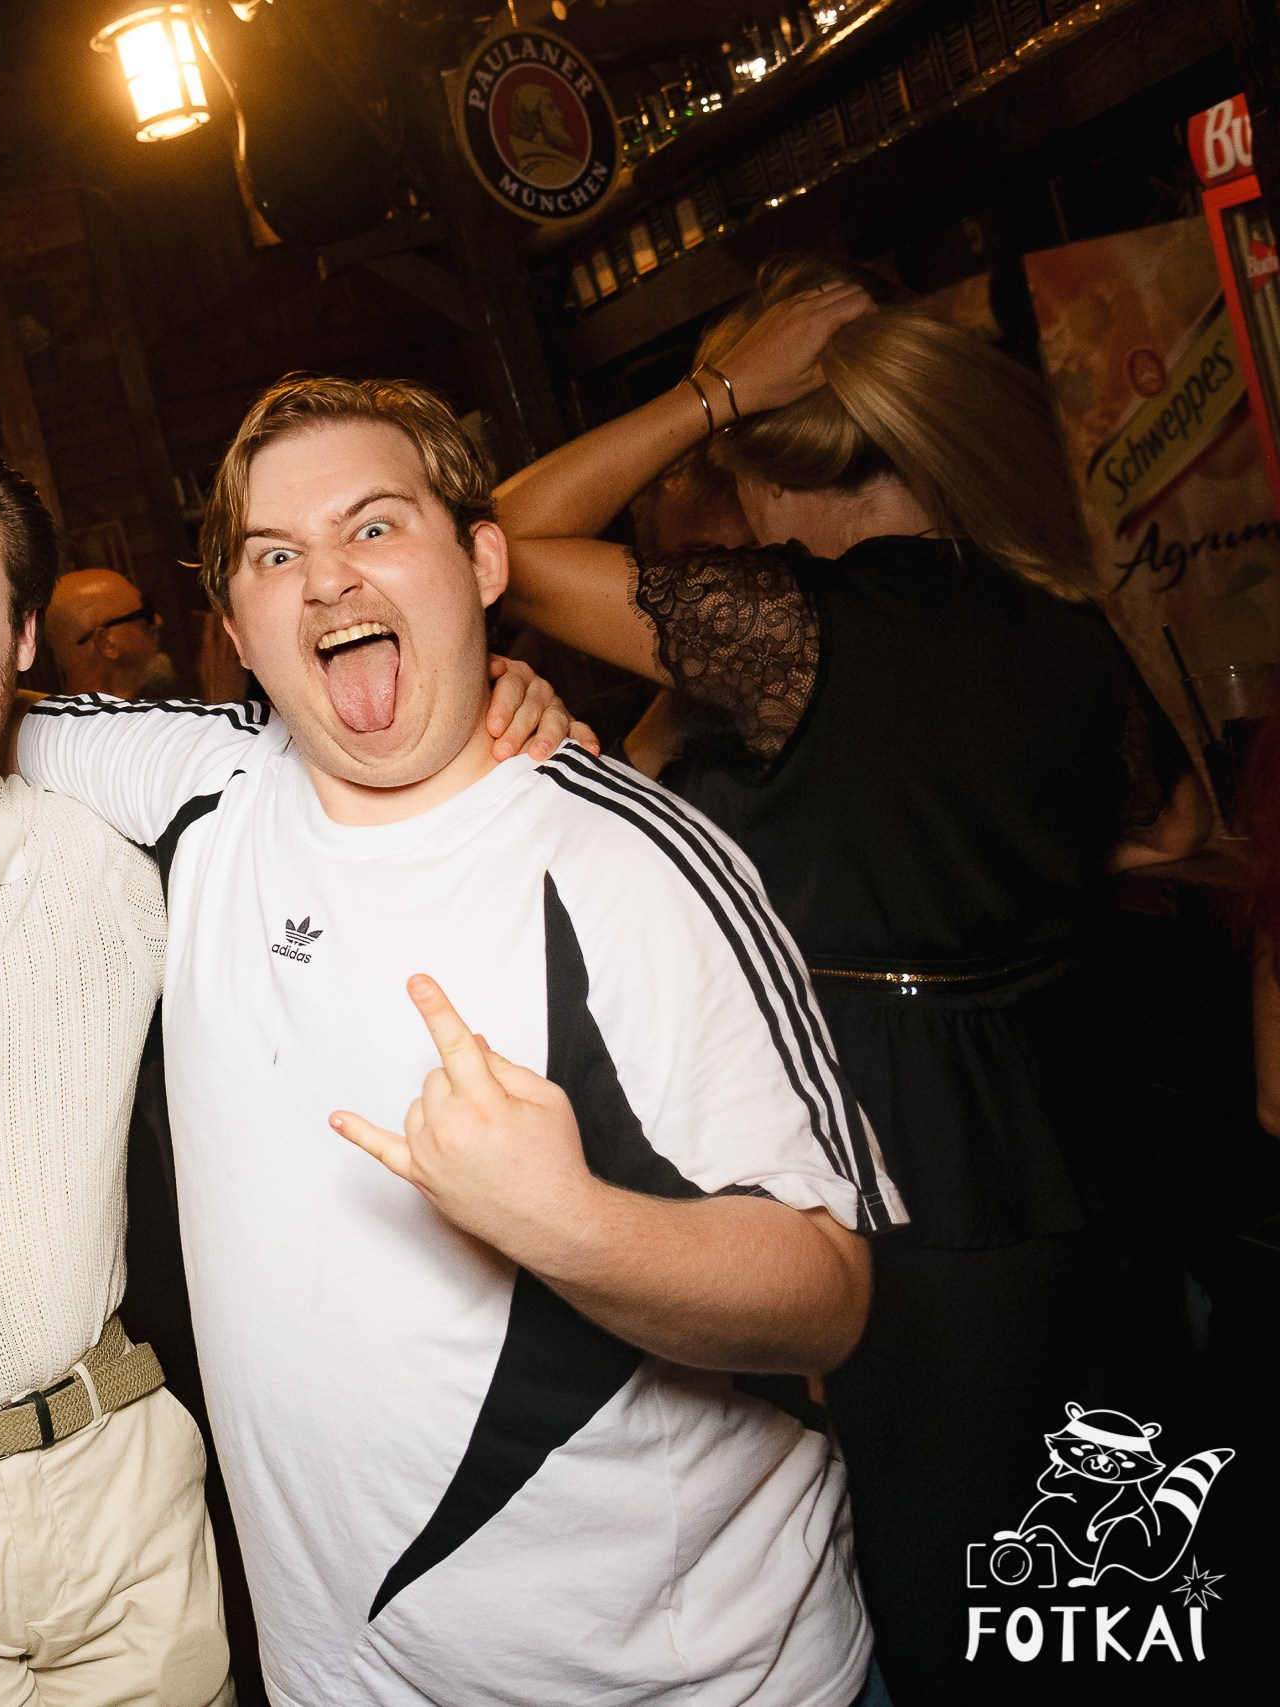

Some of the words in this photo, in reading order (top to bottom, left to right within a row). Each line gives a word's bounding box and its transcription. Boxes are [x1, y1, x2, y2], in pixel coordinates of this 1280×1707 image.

[468, 37, 594, 111] PAULANER
[498, 161, 609, 212] MÜNCHEN
[1104, 340, 1233, 508] Schweppes
[271, 944, 312, 964] adidas
